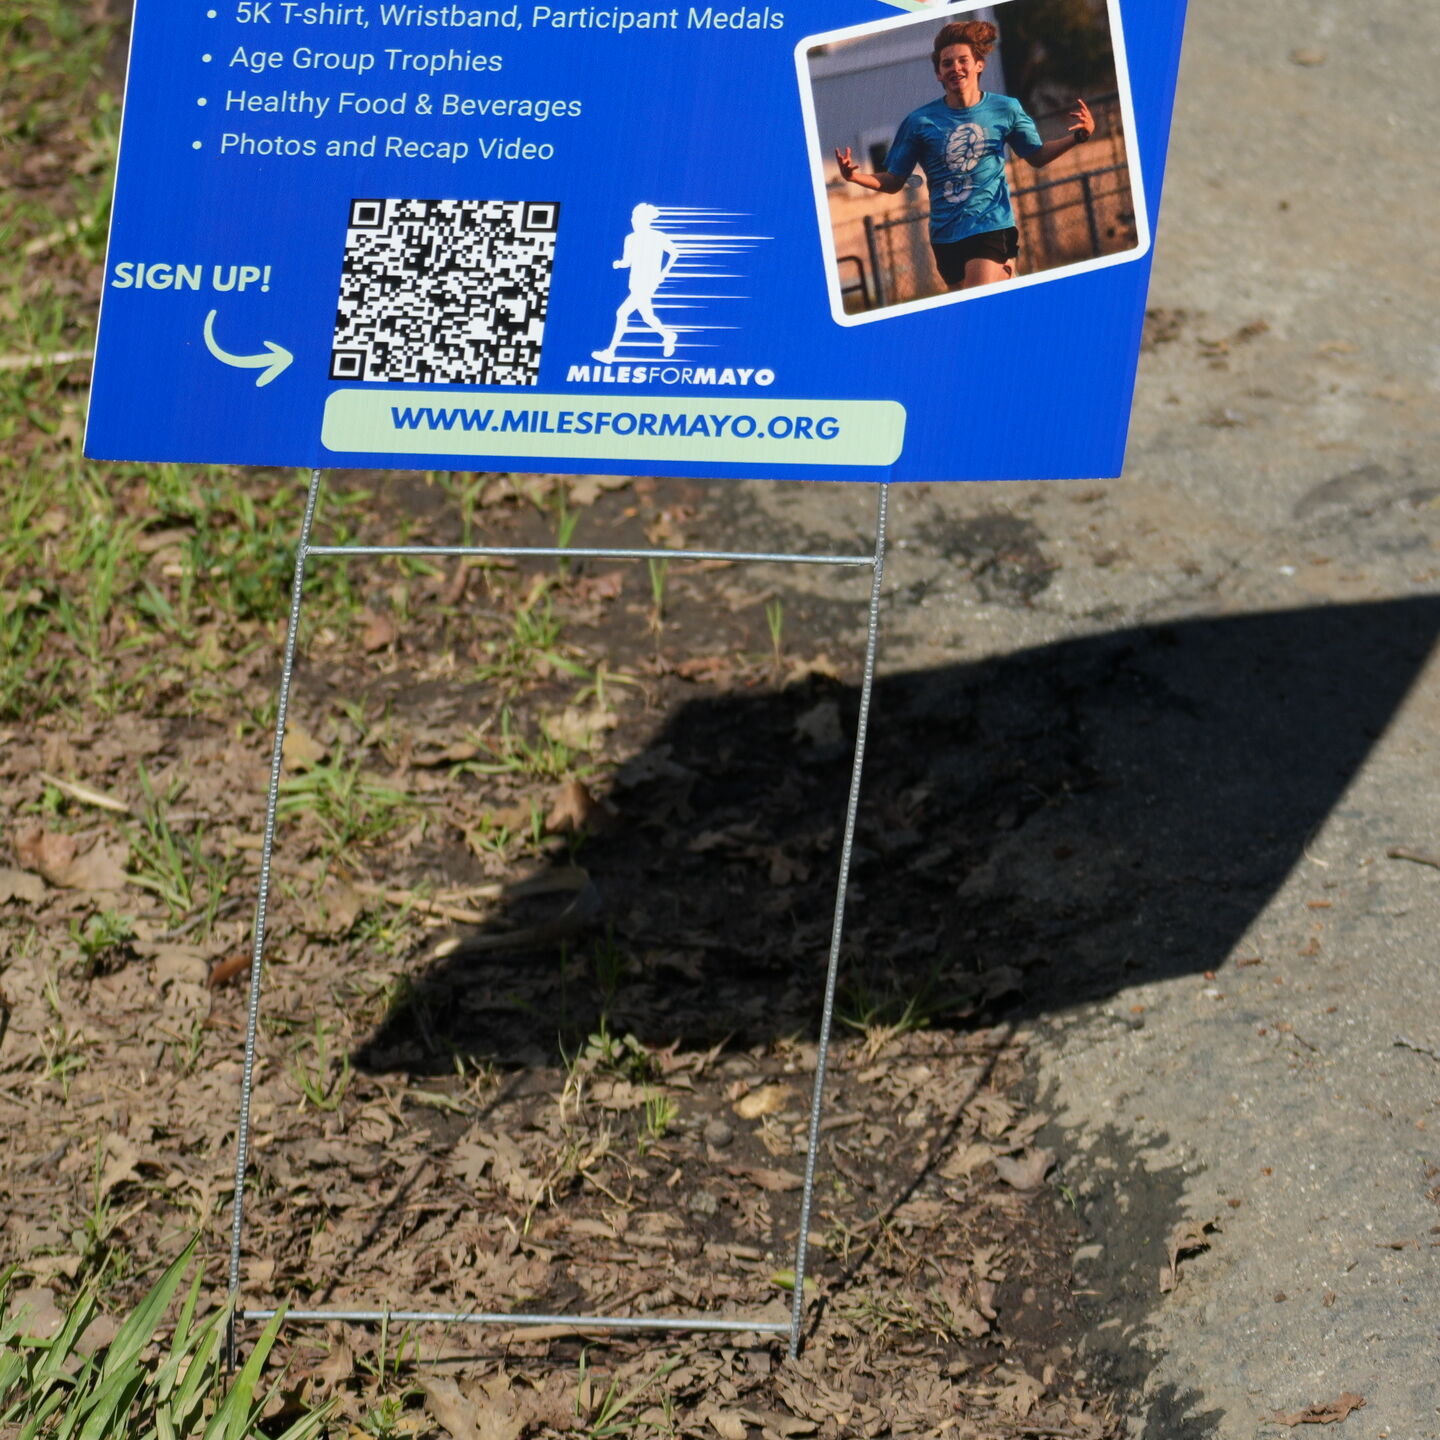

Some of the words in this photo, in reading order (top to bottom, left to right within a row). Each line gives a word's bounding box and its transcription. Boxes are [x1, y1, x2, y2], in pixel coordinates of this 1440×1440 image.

[237, 2, 271, 23] 5K
[281, 3, 368, 28] T-shirt,
[381, 5, 521, 30] Wristband,
[533, 7, 678, 33] Participant
[688, 7, 784, 29] Medals
[230, 47, 283, 73] Age
[293, 48, 374, 74] Group
[385, 49, 502, 76] Trophies
[226, 91, 329, 118] Healthy
[339, 93, 406, 114] Food
[415, 94, 432, 114] &
[443, 94, 581, 121] Beverages
[221, 133, 316, 155] Photos
[326, 136, 376, 157] and
[386, 137, 468, 163] Recap
[479, 138, 553, 159] Video
[112, 263, 202, 290] SIGN
[213, 266, 271, 292] UP!
[567, 365, 775, 386] MILESFORMAYO
[391, 407, 839, 440] WWW.MILESFORMAYO.ORG
